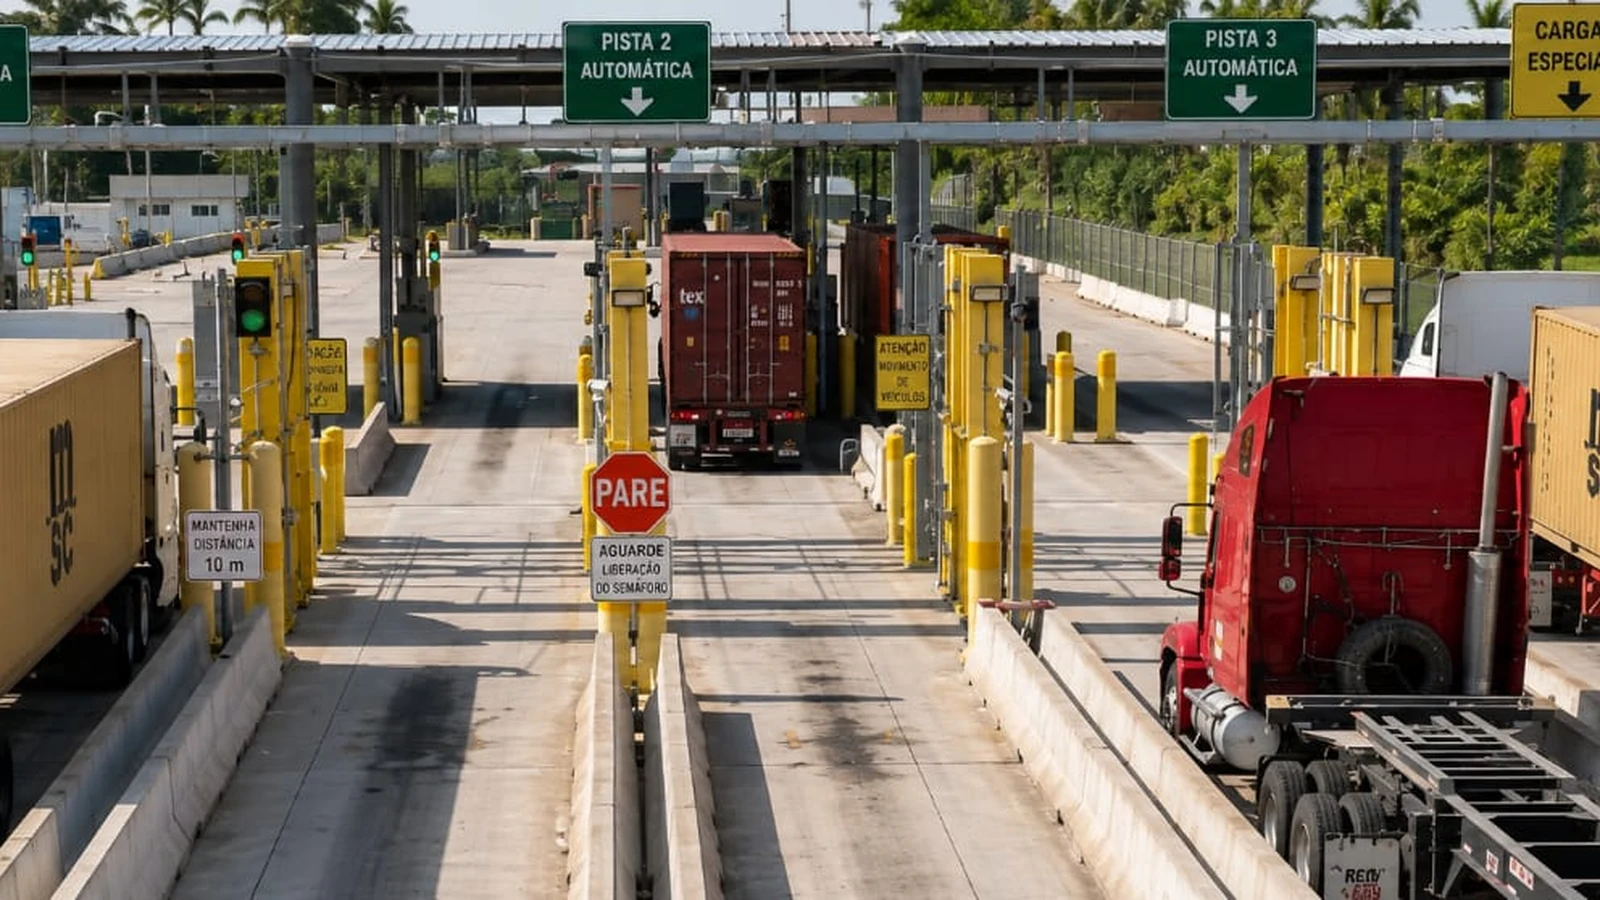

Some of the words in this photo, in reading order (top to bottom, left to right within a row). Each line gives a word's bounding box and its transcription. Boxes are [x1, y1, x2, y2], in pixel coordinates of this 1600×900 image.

[602, 32, 654, 51] PISTA
[660, 32, 671, 51] 2
[1205, 29, 1259, 48] PISTA
[1266, 29, 1277, 48] 3
[580, 58, 693, 79] AUTOMÁTICA
[1183, 55, 1298, 77] AUTOMÁTICA
[880, 340, 926, 355] ATENÇÃO
[596, 478, 665, 508] PARE
[191, 519, 255, 532] MANTENHA
[194, 535, 255, 551] DISTÂNCIA
[600, 544, 665, 558] AGUARDE
[205, 556, 223, 573] 10
[229, 560, 244, 572] m
[602, 561, 661, 577] LIBERAÇÃO
[595, 581, 610, 595] DO
[612, 577, 668, 595] SEMÁFORO
